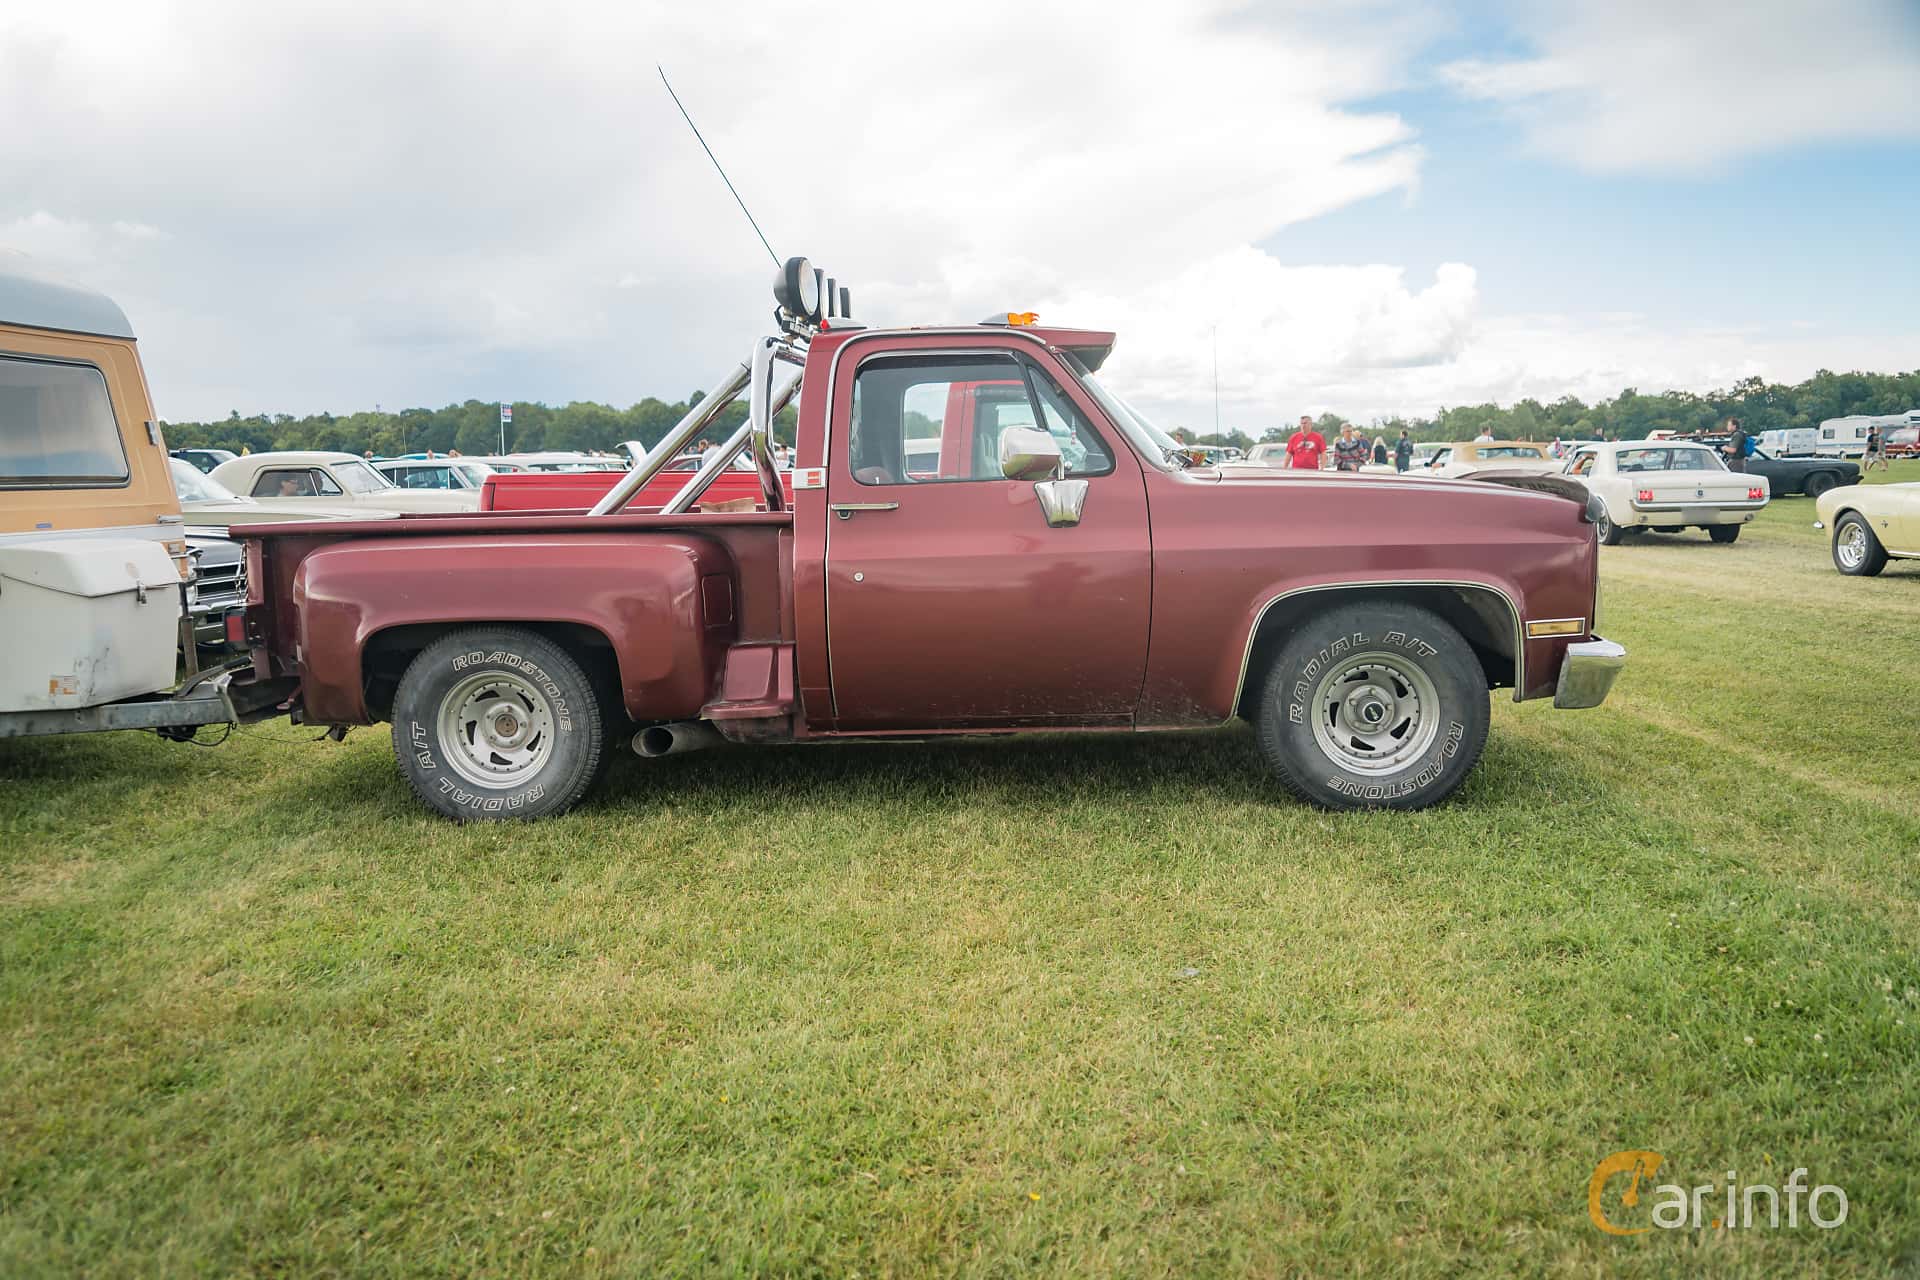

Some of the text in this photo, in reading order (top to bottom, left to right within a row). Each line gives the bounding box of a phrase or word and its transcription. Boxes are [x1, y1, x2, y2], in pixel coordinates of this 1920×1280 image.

[452, 651, 573, 732] ROADSTONE
[1289, 631, 1438, 724] RADIAL A/T
[412, 721, 545, 811] RADIAL A/T
[1327, 720, 1465, 799] ROADSTONE
